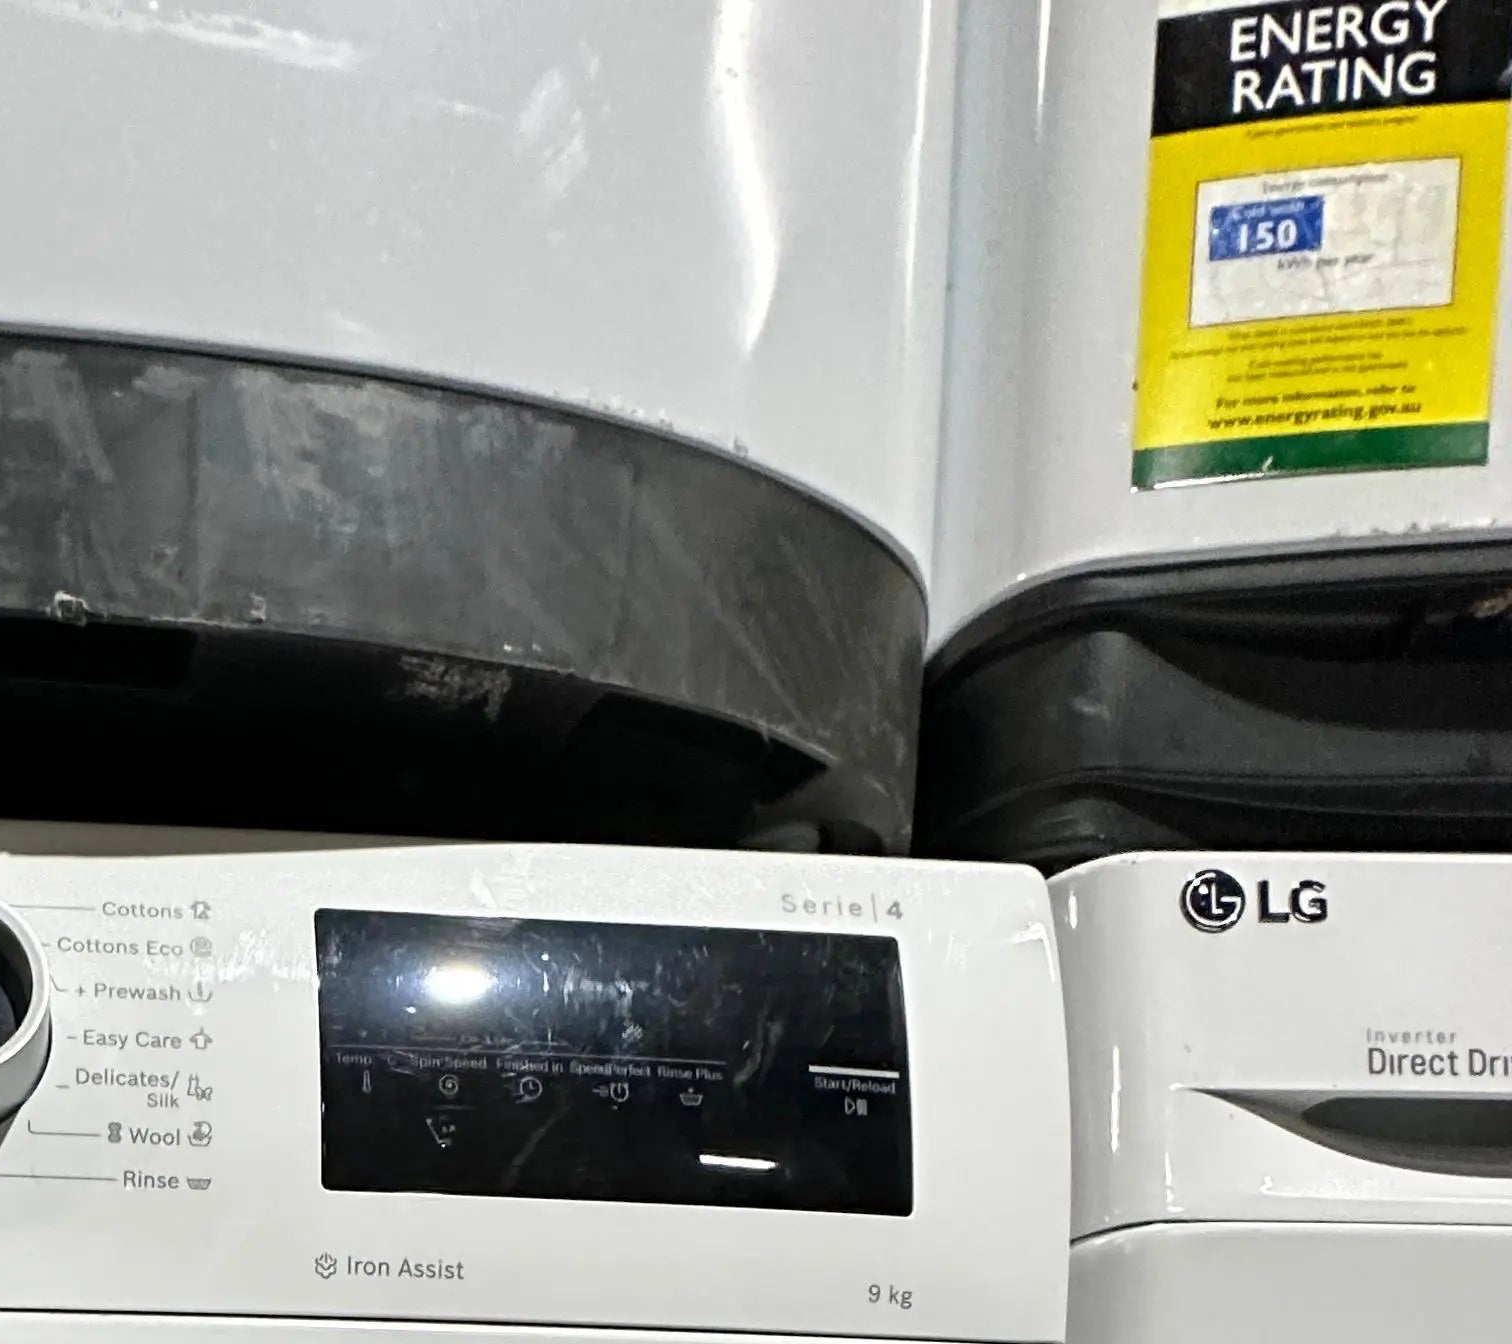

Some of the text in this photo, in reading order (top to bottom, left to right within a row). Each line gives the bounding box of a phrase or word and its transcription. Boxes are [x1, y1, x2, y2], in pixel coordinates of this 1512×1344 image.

[1230, 0, 1448, 62] ENERGY
[1232, 50, 1436, 114] RATING
[1238, 218, 1298, 253] 150
[102, 901, 184, 920] Cottons
[781, 892, 904, 920] Serie 4
[1257, 879, 1328, 923] LG
[57, 936, 183, 957] Cottons Eco
[94, 982, 181, 1001] Prewash
[83, 1029, 182, 1051] Easy Care
[1366, 1027, 1457, 1045] Inverter
[1367, 1046, 1512, 1077] Direct Dri
[76, 1067, 179, 1090] Delicates/
[814, 1076, 896, 1095] Start/Reload
[147, 1092, 180, 1109] Silk
[129, 1127, 180, 1146] Wool
[123, 1169, 179, 1189] Rinse
[347, 1255, 464, 1280] Iron Assist
[868, 1283, 913, 1310] 9 kg
